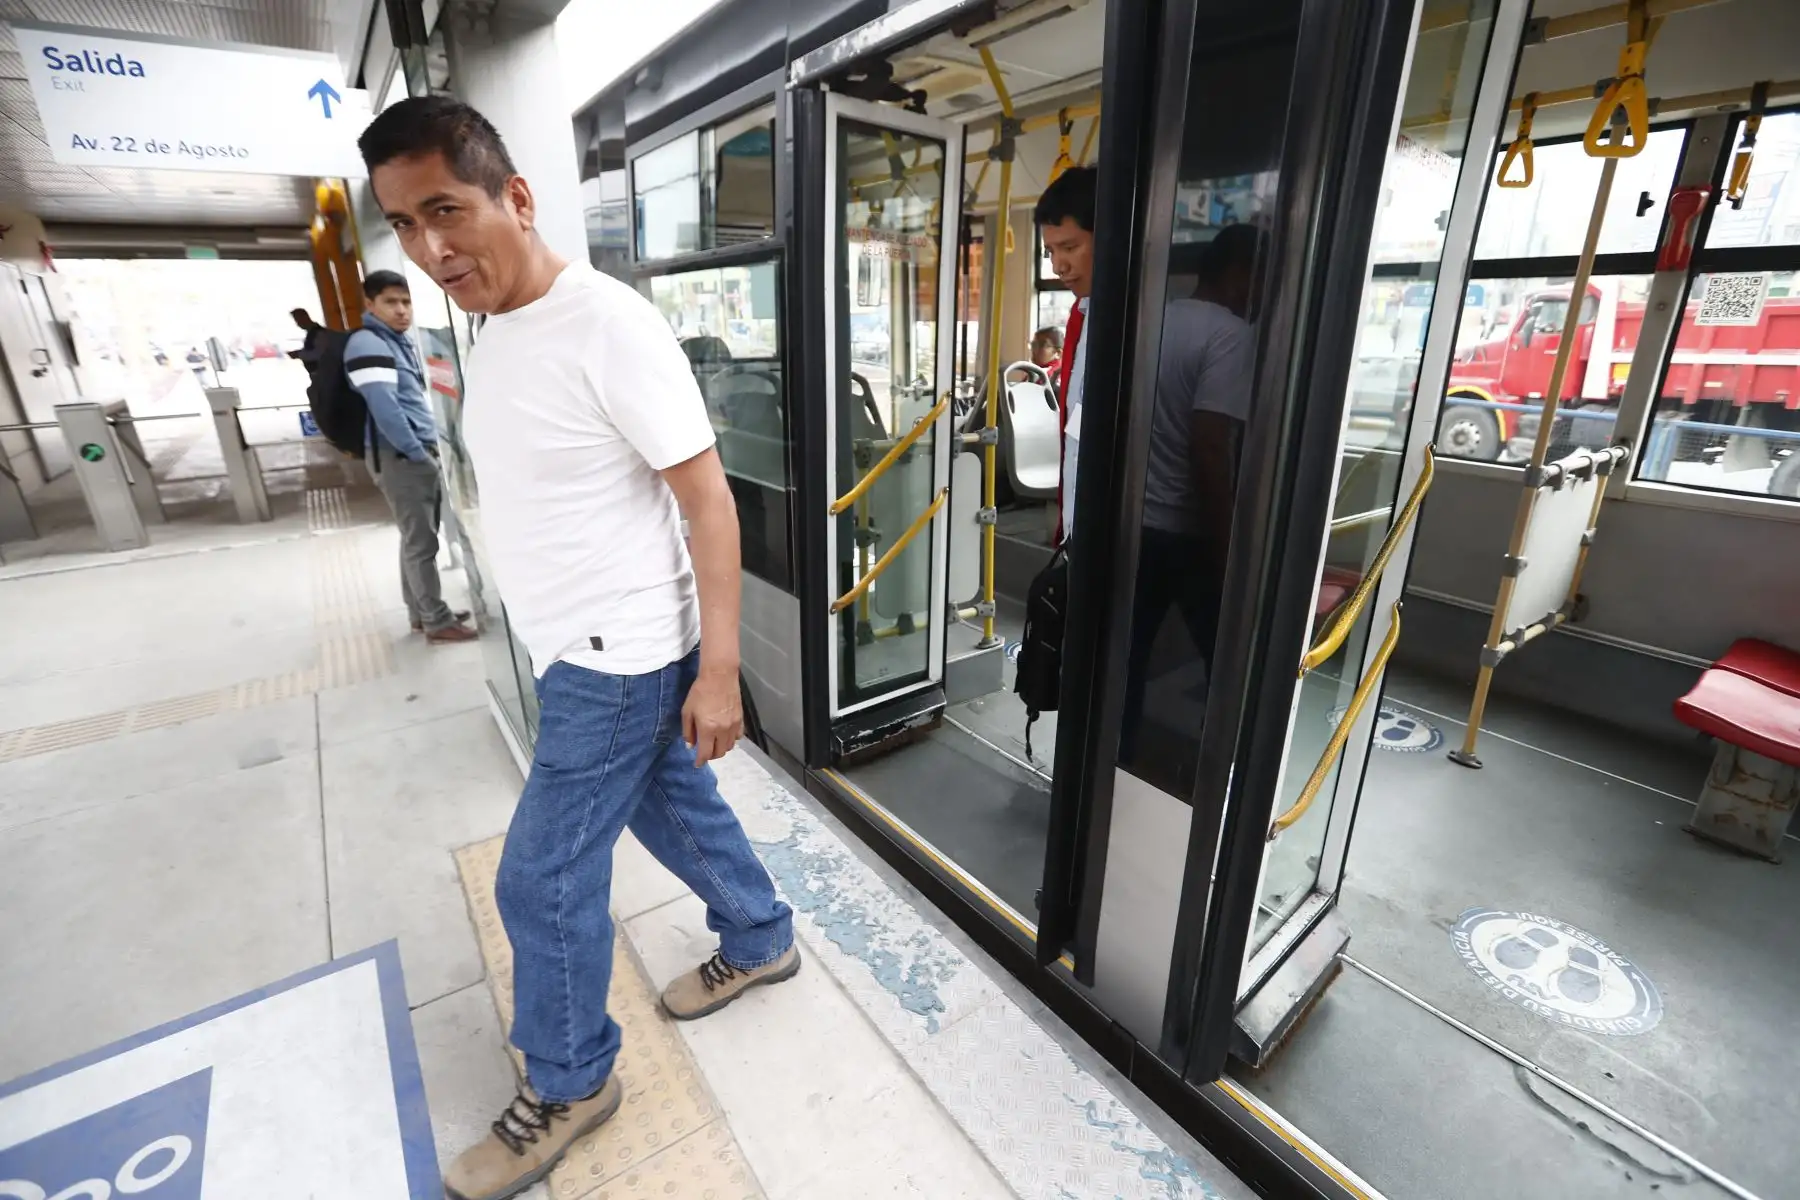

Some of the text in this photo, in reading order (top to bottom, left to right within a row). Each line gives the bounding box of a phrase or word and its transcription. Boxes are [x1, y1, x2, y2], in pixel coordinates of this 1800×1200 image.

[42, 46, 145, 78] Salida
[51, 75, 86, 93] Exit
[72, 133, 249, 160] Av. 22 de Agosto
[863, 244, 873, 256] DE
[873, 245, 883, 257] LA
[1514, 911, 1631, 968] PARESE AQUI
[1453, 930, 1643, 1032] GUARDE SU DISTANCIA
